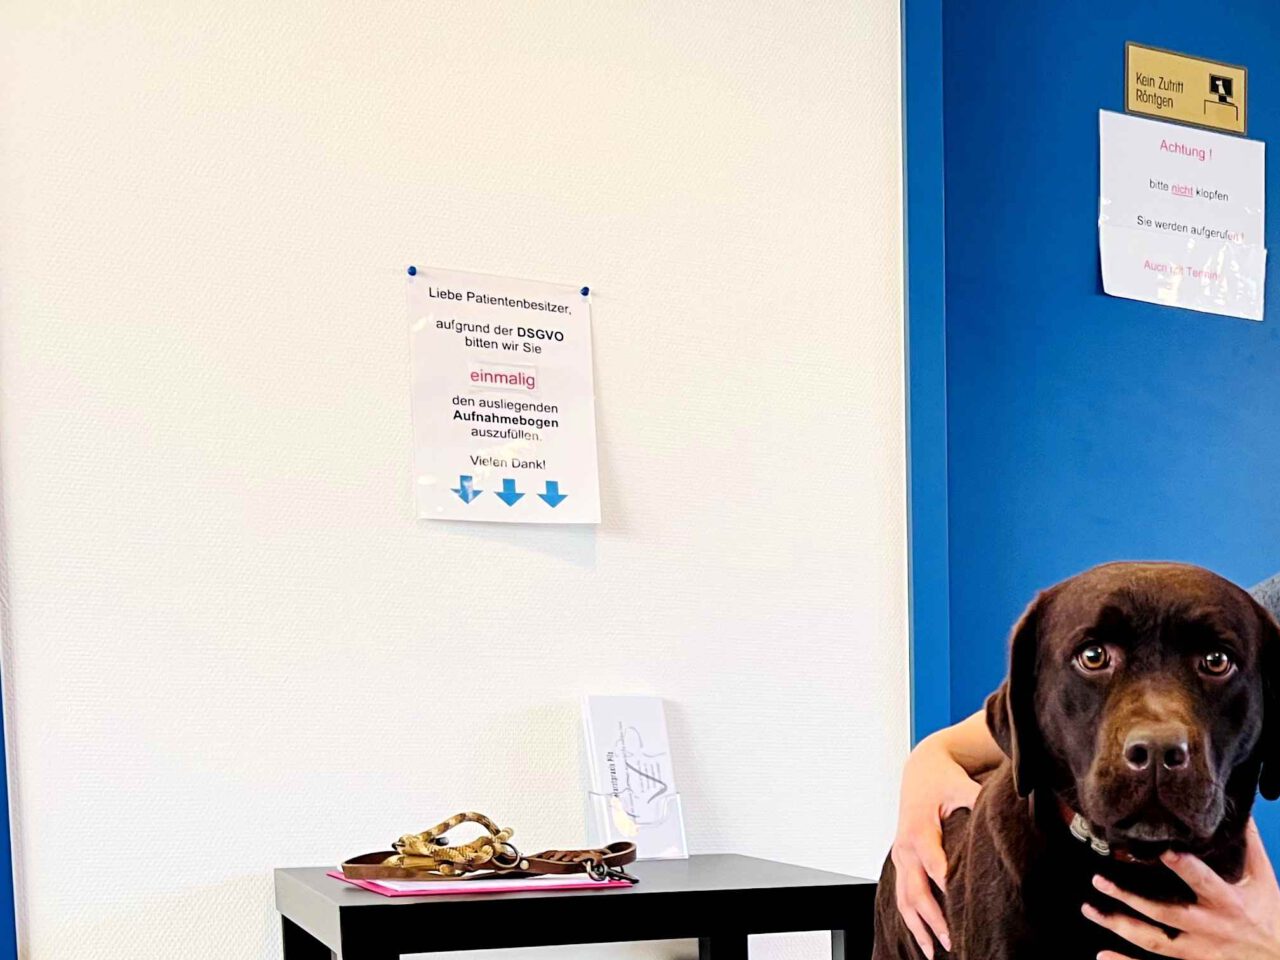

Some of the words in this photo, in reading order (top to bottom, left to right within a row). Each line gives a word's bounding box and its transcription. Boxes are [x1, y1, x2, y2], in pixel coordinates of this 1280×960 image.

[1136, 72, 1155, 88] Kein
[1158, 76, 1184, 93] Zutritt
[1136, 89, 1174, 109] Röntgen
[1160, 139, 1205, 161] Achtung
[1149, 178, 1169, 192] bitte
[1171, 183, 1194, 198] nicht
[1195, 186, 1229, 202] klopfen
[1137, 215, 1152, 227] Sie
[1155, 219, 1188, 233] werden
[428, 287, 462, 301] Liebe
[466, 291, 572, 315] Patientenbesitzer,
[436, 319, 490, 334] aufgrund
[493, 323, 513, 336] der
[517, 327, 564, 342] DSGVO
[465, 336, 499, 350] bitten
[502, 340, 519, 352] wir
[523, 342, 542, 354] Sie
[470, 369, 536, 390] einmalig
[452, 395, 475, 407] den
[479, 398, 558, 414] ausliegenden
[453, 410, 559, 428] Aufnahmebogen
[471, 428, 543, 442] auszufüllen.
[470, 455, 508, 468] Vielen
[512, 458, 546, 470] Dank!
